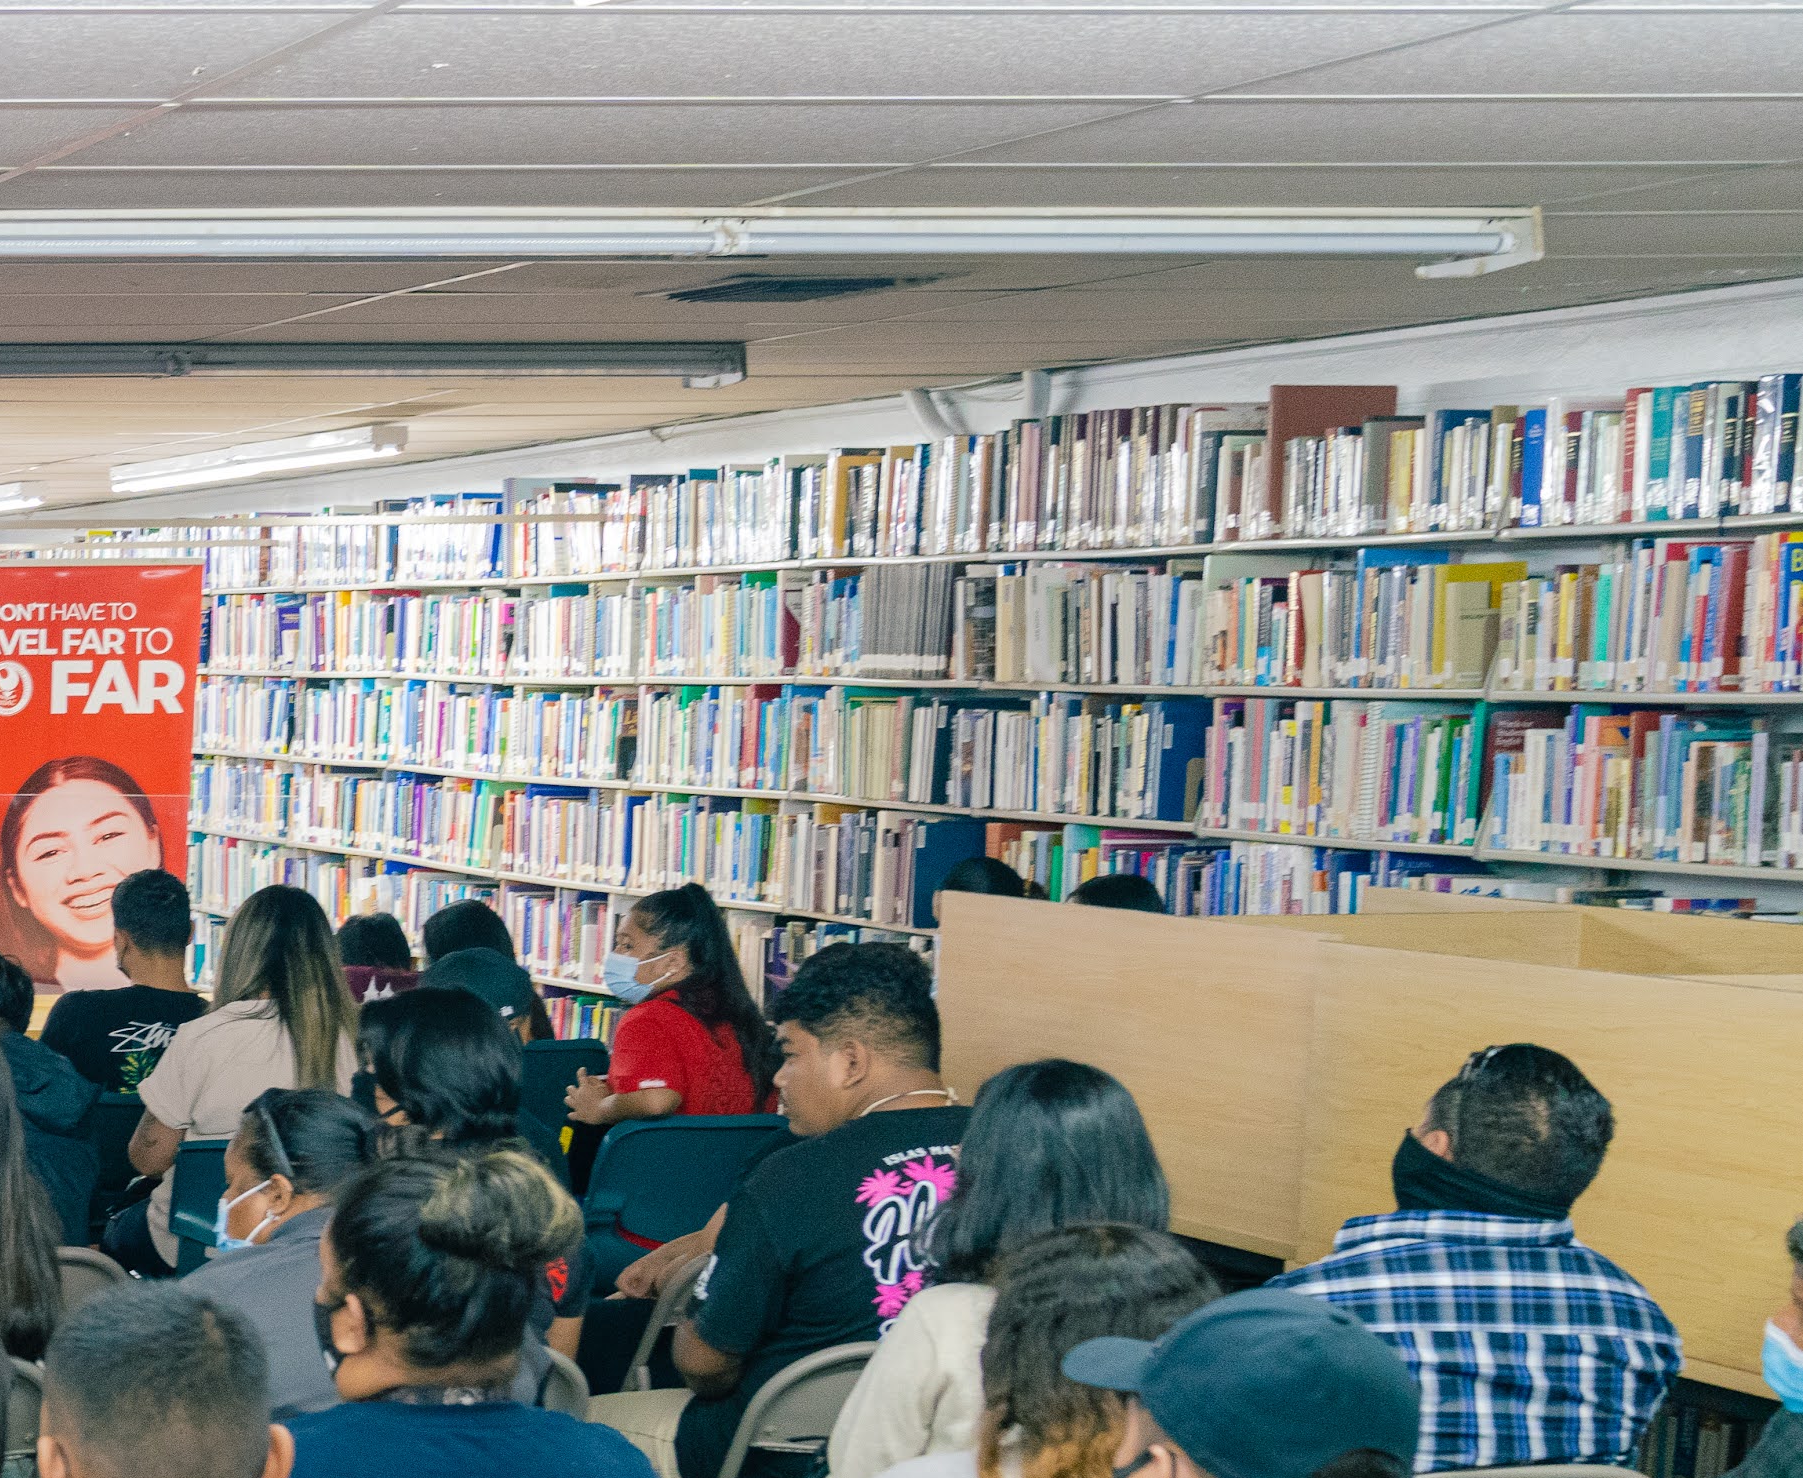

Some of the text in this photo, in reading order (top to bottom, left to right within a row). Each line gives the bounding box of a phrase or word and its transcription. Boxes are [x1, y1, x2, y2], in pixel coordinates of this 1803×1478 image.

[50, 601, 107, 621] HAVE
[108, 601, 137, 621] TO
[61, 627, 125, 655] FAR
[127, 626, 173, 655] TO
[50, 659, 186, 714] FAR
